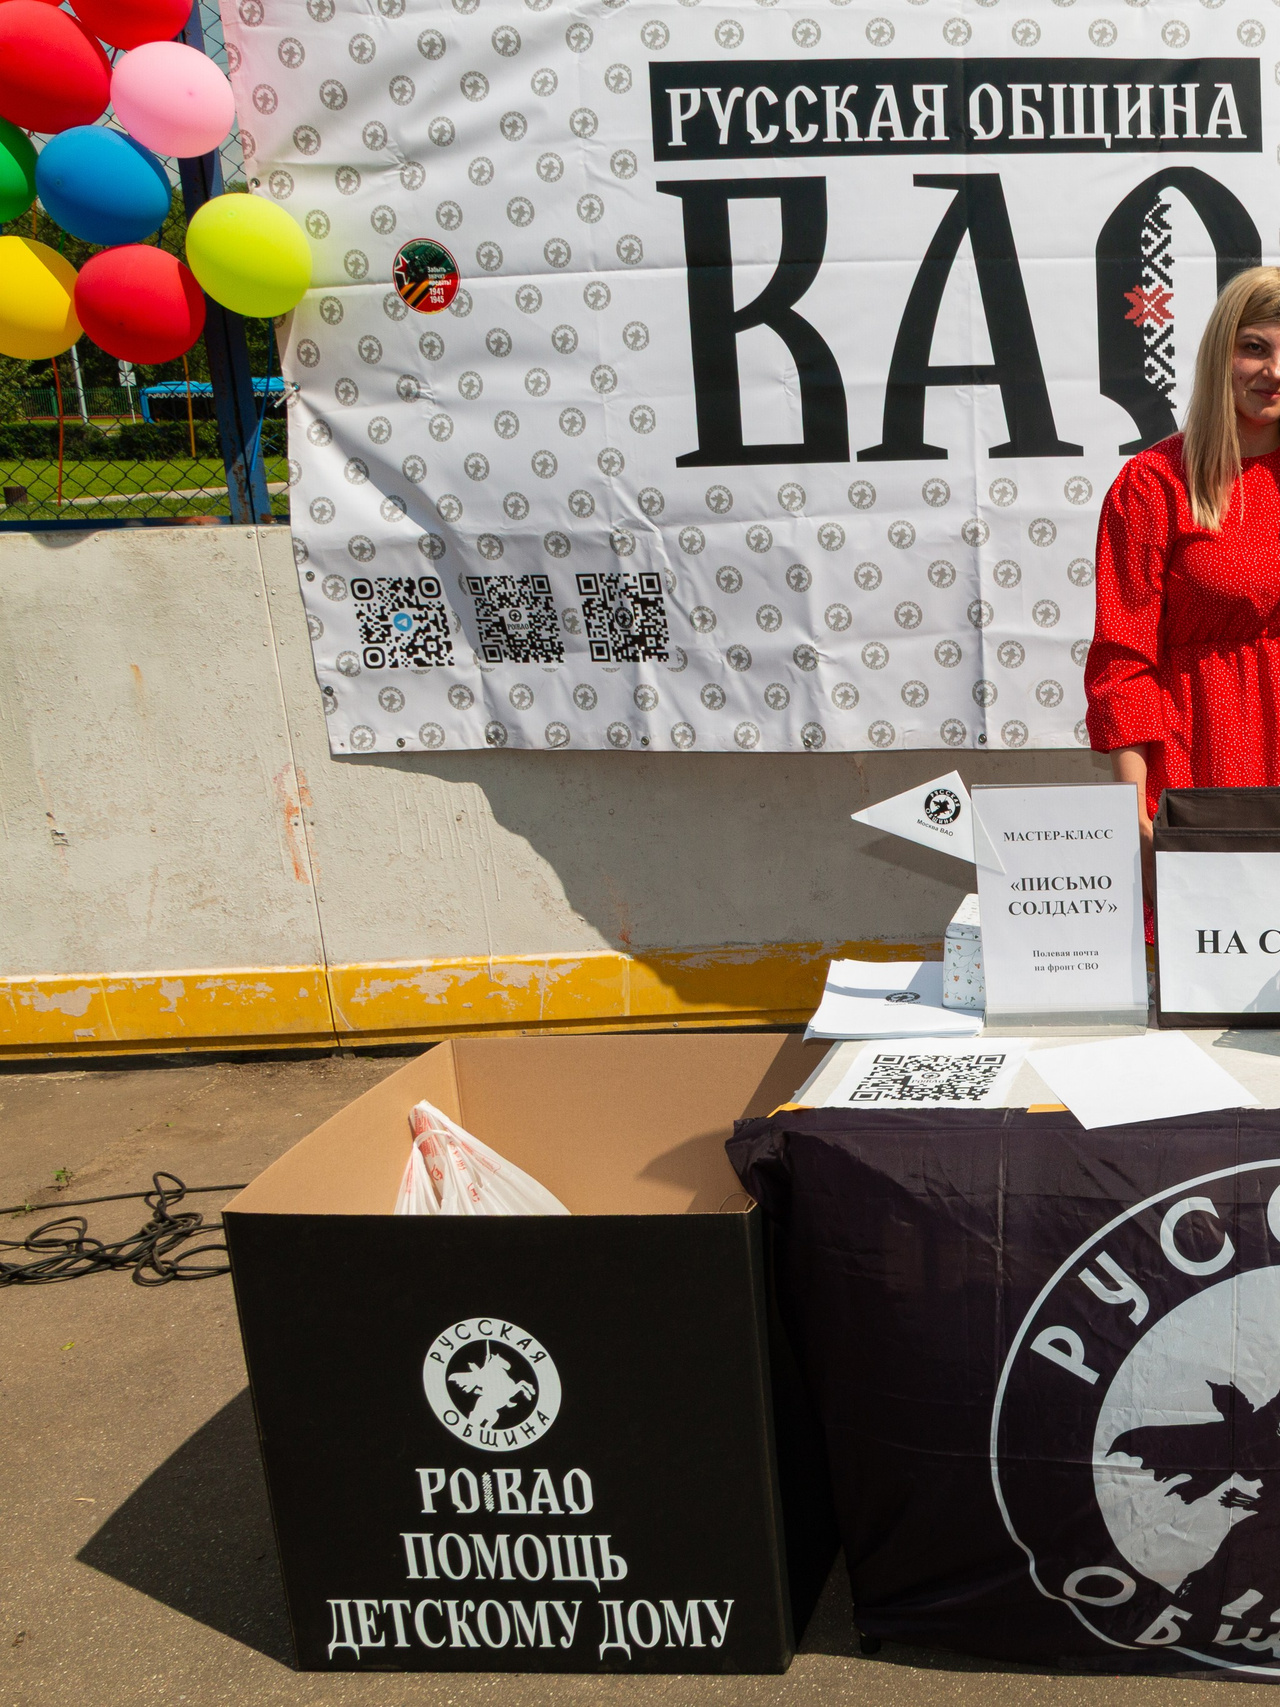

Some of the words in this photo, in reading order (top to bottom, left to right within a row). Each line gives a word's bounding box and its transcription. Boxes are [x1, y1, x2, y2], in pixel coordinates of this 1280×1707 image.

[665, 84, 949, 147] РУССКАЯ
[969, 82, 1248, 149] ОБЩИНА
[429, 287, 444, 295] 1941
[429, 295, 445, 304] 1945
[916, 818, 939, 832] Москва
[939, 827, 954, 837] ВАО
[1003, 829, 1114, 842] МАСТЕР-КЛАСС
[1010, 875, 1112, 892] «ПИСЬМО
[1008, 899, 1118, 917] СОЛДАТУ»
[1196, 928, 1248, 955] НА
[1032, 950, 1071, 958] Полевая
[1034, 964, 1045, 972] на
[1047, 963, 1075, 973] фронт
[1077, 962, 1099, 971] СВО
[430, 1319, 547, 1364] РУССКАЯ
[443, 1409, 550, 1447] ОБЩИНА
[493, 1467, 593, 1514] ВАО
[399, 1532, 628, 1592] ПОМОЩЬ
[326, 1599, 582, 1661] ДЕТСКОМУ
[598, 1599, 735, 1661] ДОМУ
